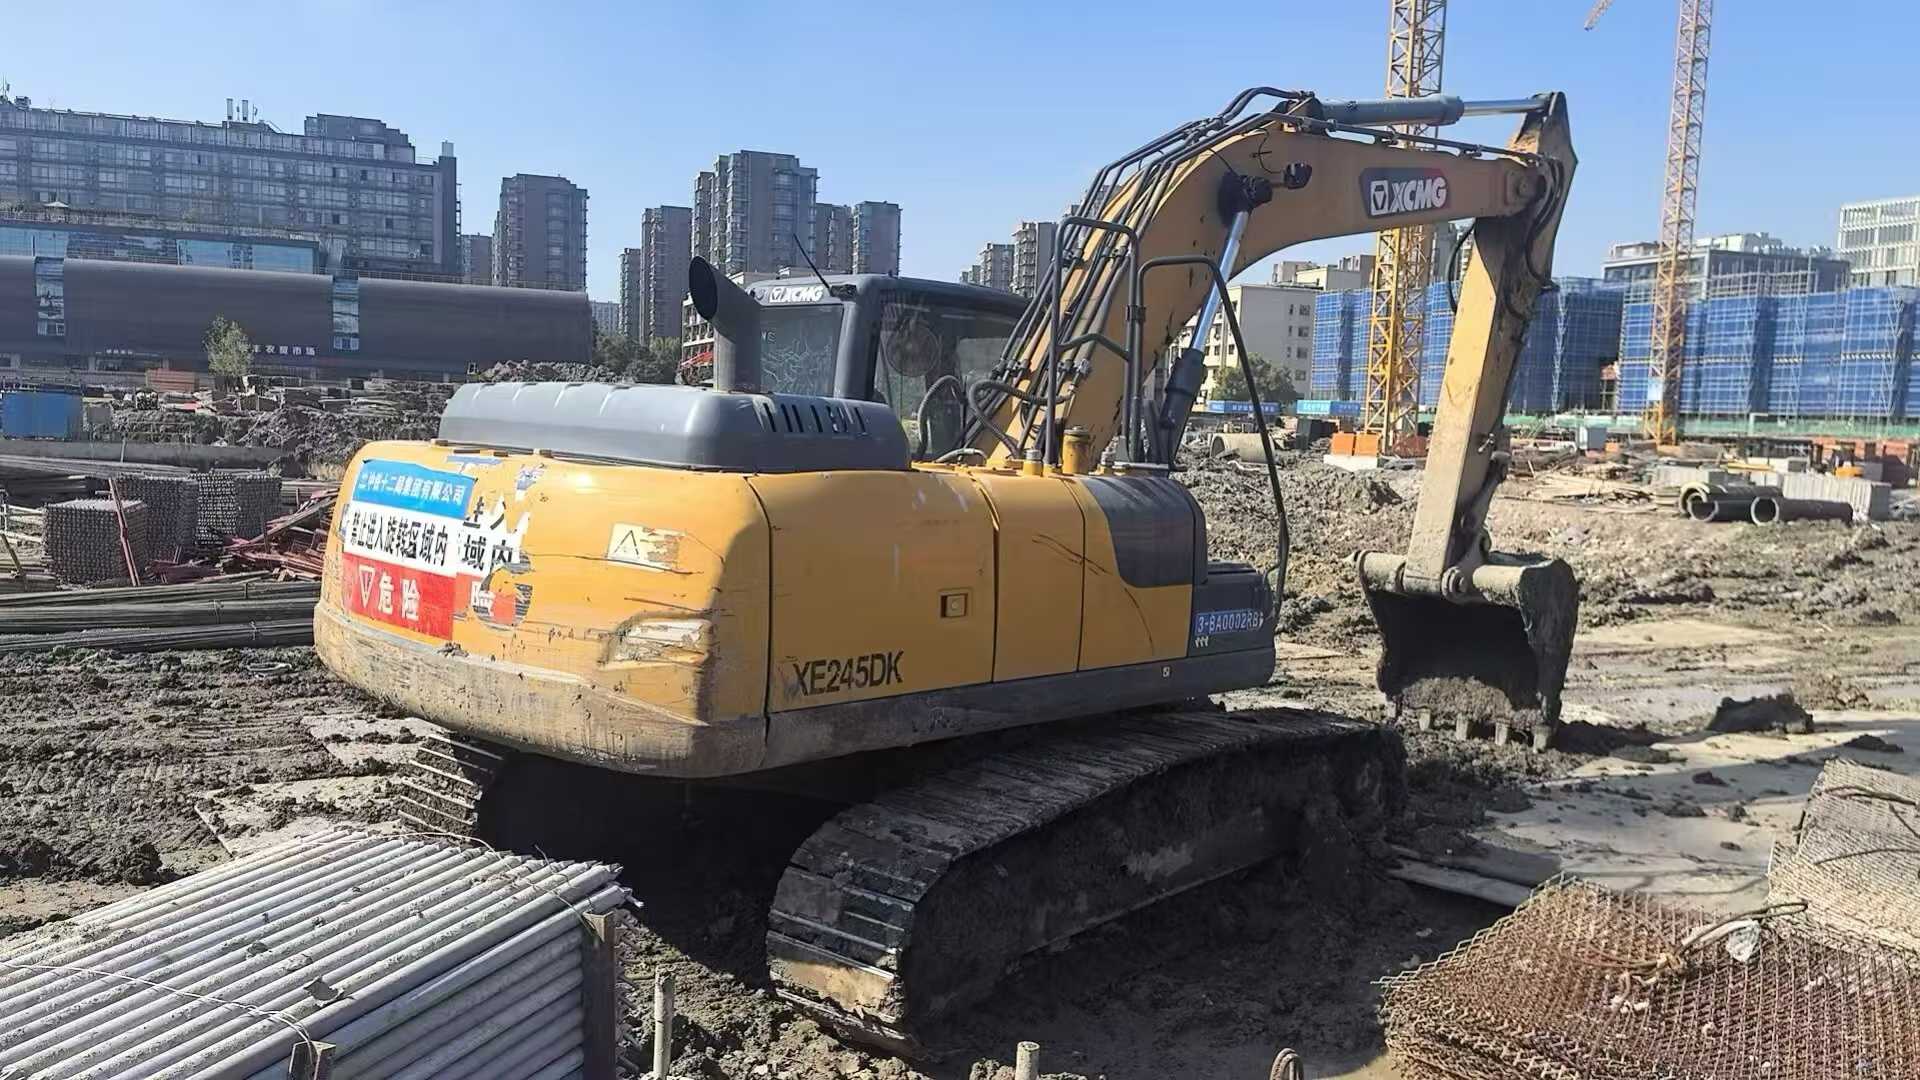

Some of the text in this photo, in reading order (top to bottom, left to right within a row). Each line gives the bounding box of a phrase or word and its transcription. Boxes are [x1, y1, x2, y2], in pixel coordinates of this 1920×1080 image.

[1390, 177, 1447, 212] XCMG
[780, 286, 823, 303] XCMG
[350, 511, 449, 567] 禁止进入旋转区域内
[378, 570, 421, 622] 危险
[793, 651, 904, 696] XE245DK
